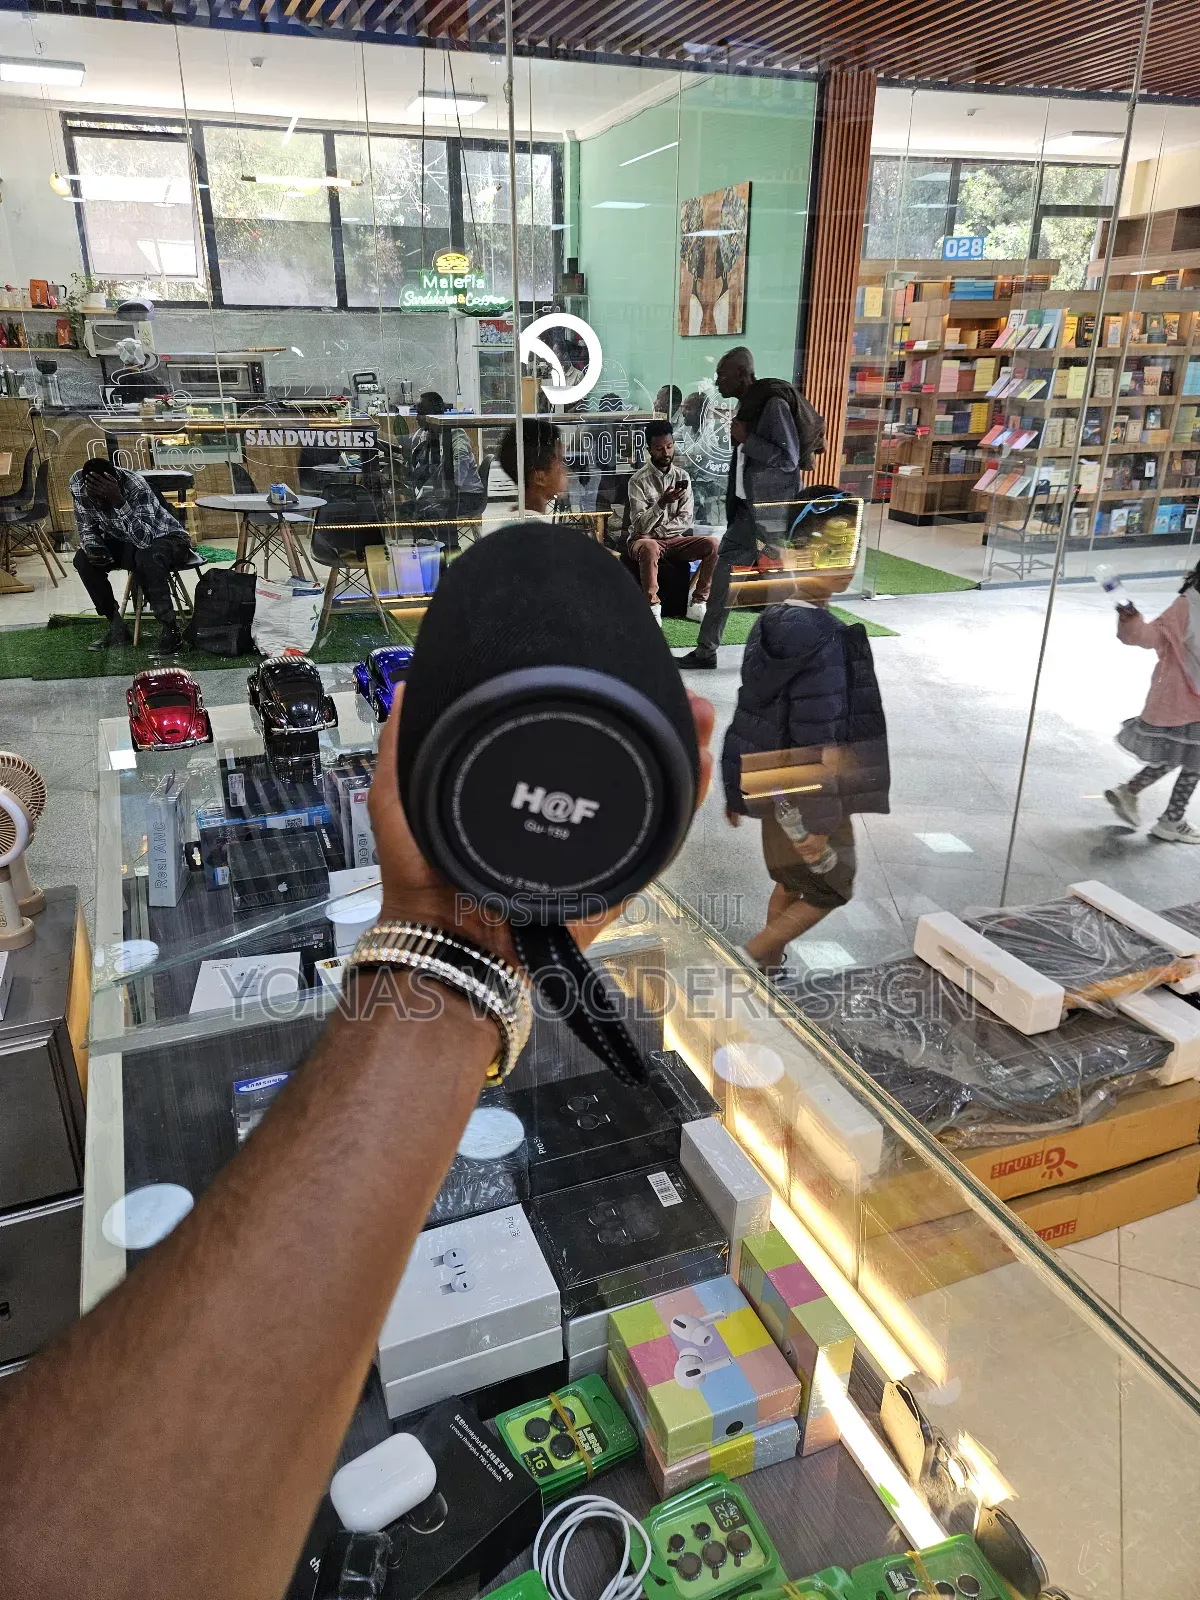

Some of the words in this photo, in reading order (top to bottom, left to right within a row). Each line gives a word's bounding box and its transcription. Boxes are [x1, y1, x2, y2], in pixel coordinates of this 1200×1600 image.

[945, 238, 982, 258] 028
[465, 293, 509, 307] Coffee
[245, 429, 375, 448] SANDWICHES
[561, 429, 646, 467] URGER
[511, 781, 600, 824] H@F
[153, 821, 167, 854] ANC
[245, 1078, 283, 1089] SAMSUNG
[532, 1452, 548, 1470] 16
[485, 1463, 503, 1483] Earbuds
[715, 1504, 733, 1528] S22
[310, 1556, 321, 1573] th
